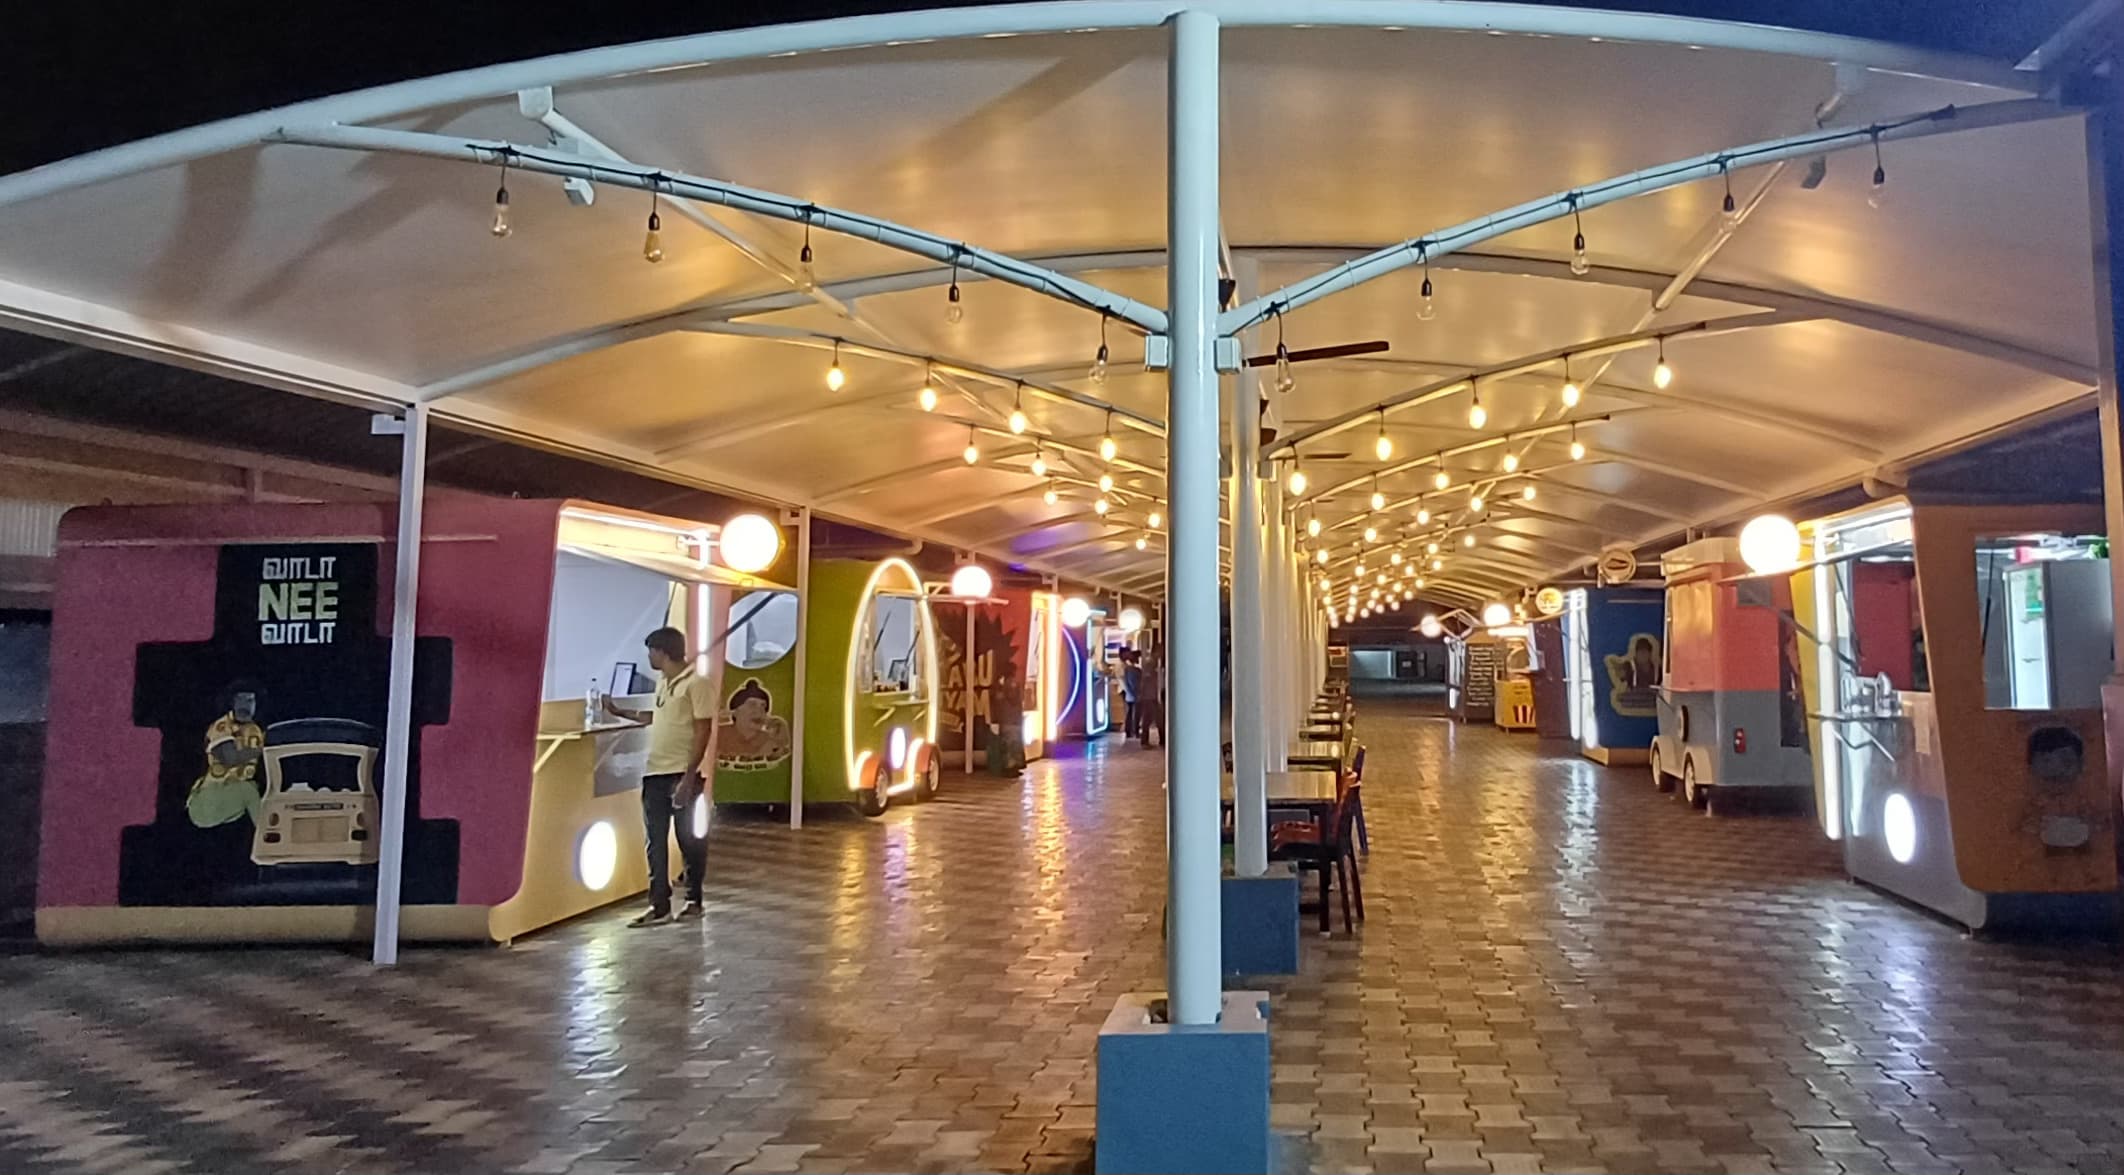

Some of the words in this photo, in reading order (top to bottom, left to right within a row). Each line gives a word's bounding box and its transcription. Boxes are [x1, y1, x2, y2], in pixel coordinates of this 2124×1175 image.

[262, 556, 336, 580] வாடா
[258, 582, 338, 621] NEE
[261, 622, 336, 646] வாடா
